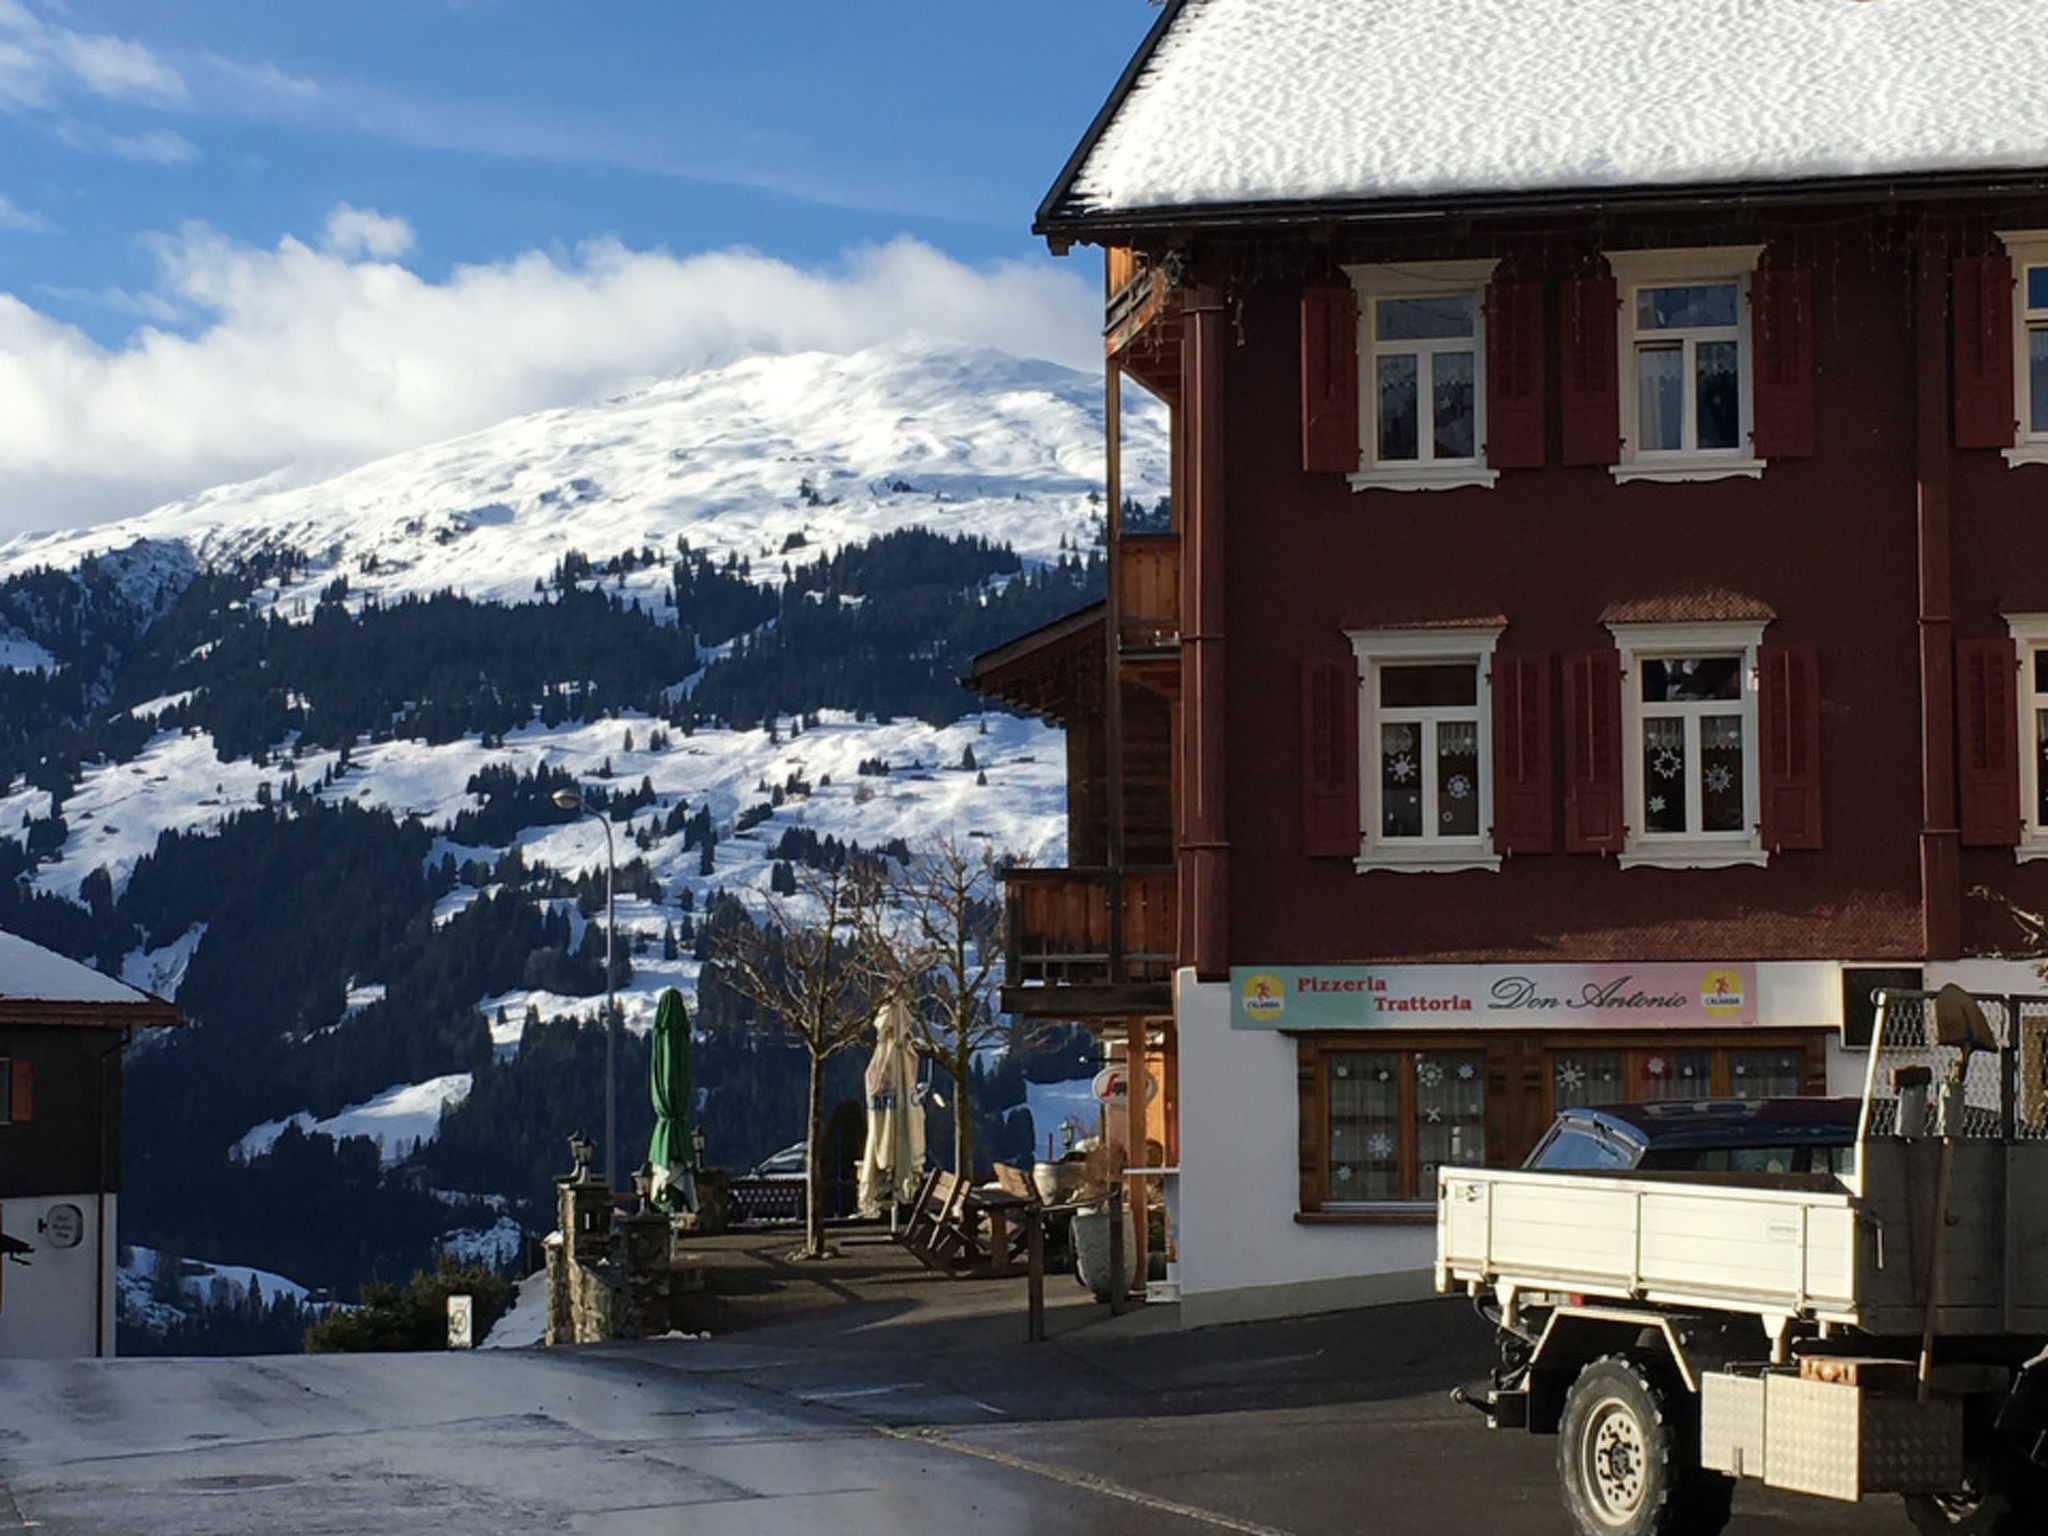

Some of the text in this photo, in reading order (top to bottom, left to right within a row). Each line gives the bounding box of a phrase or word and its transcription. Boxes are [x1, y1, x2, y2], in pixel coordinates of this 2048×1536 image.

[1298, 976, 1387, 992] Pizzeria
[1487, 975, 1688, 1009] Don Antonio
[1374, 995, 1472, 1012] Trattoria
